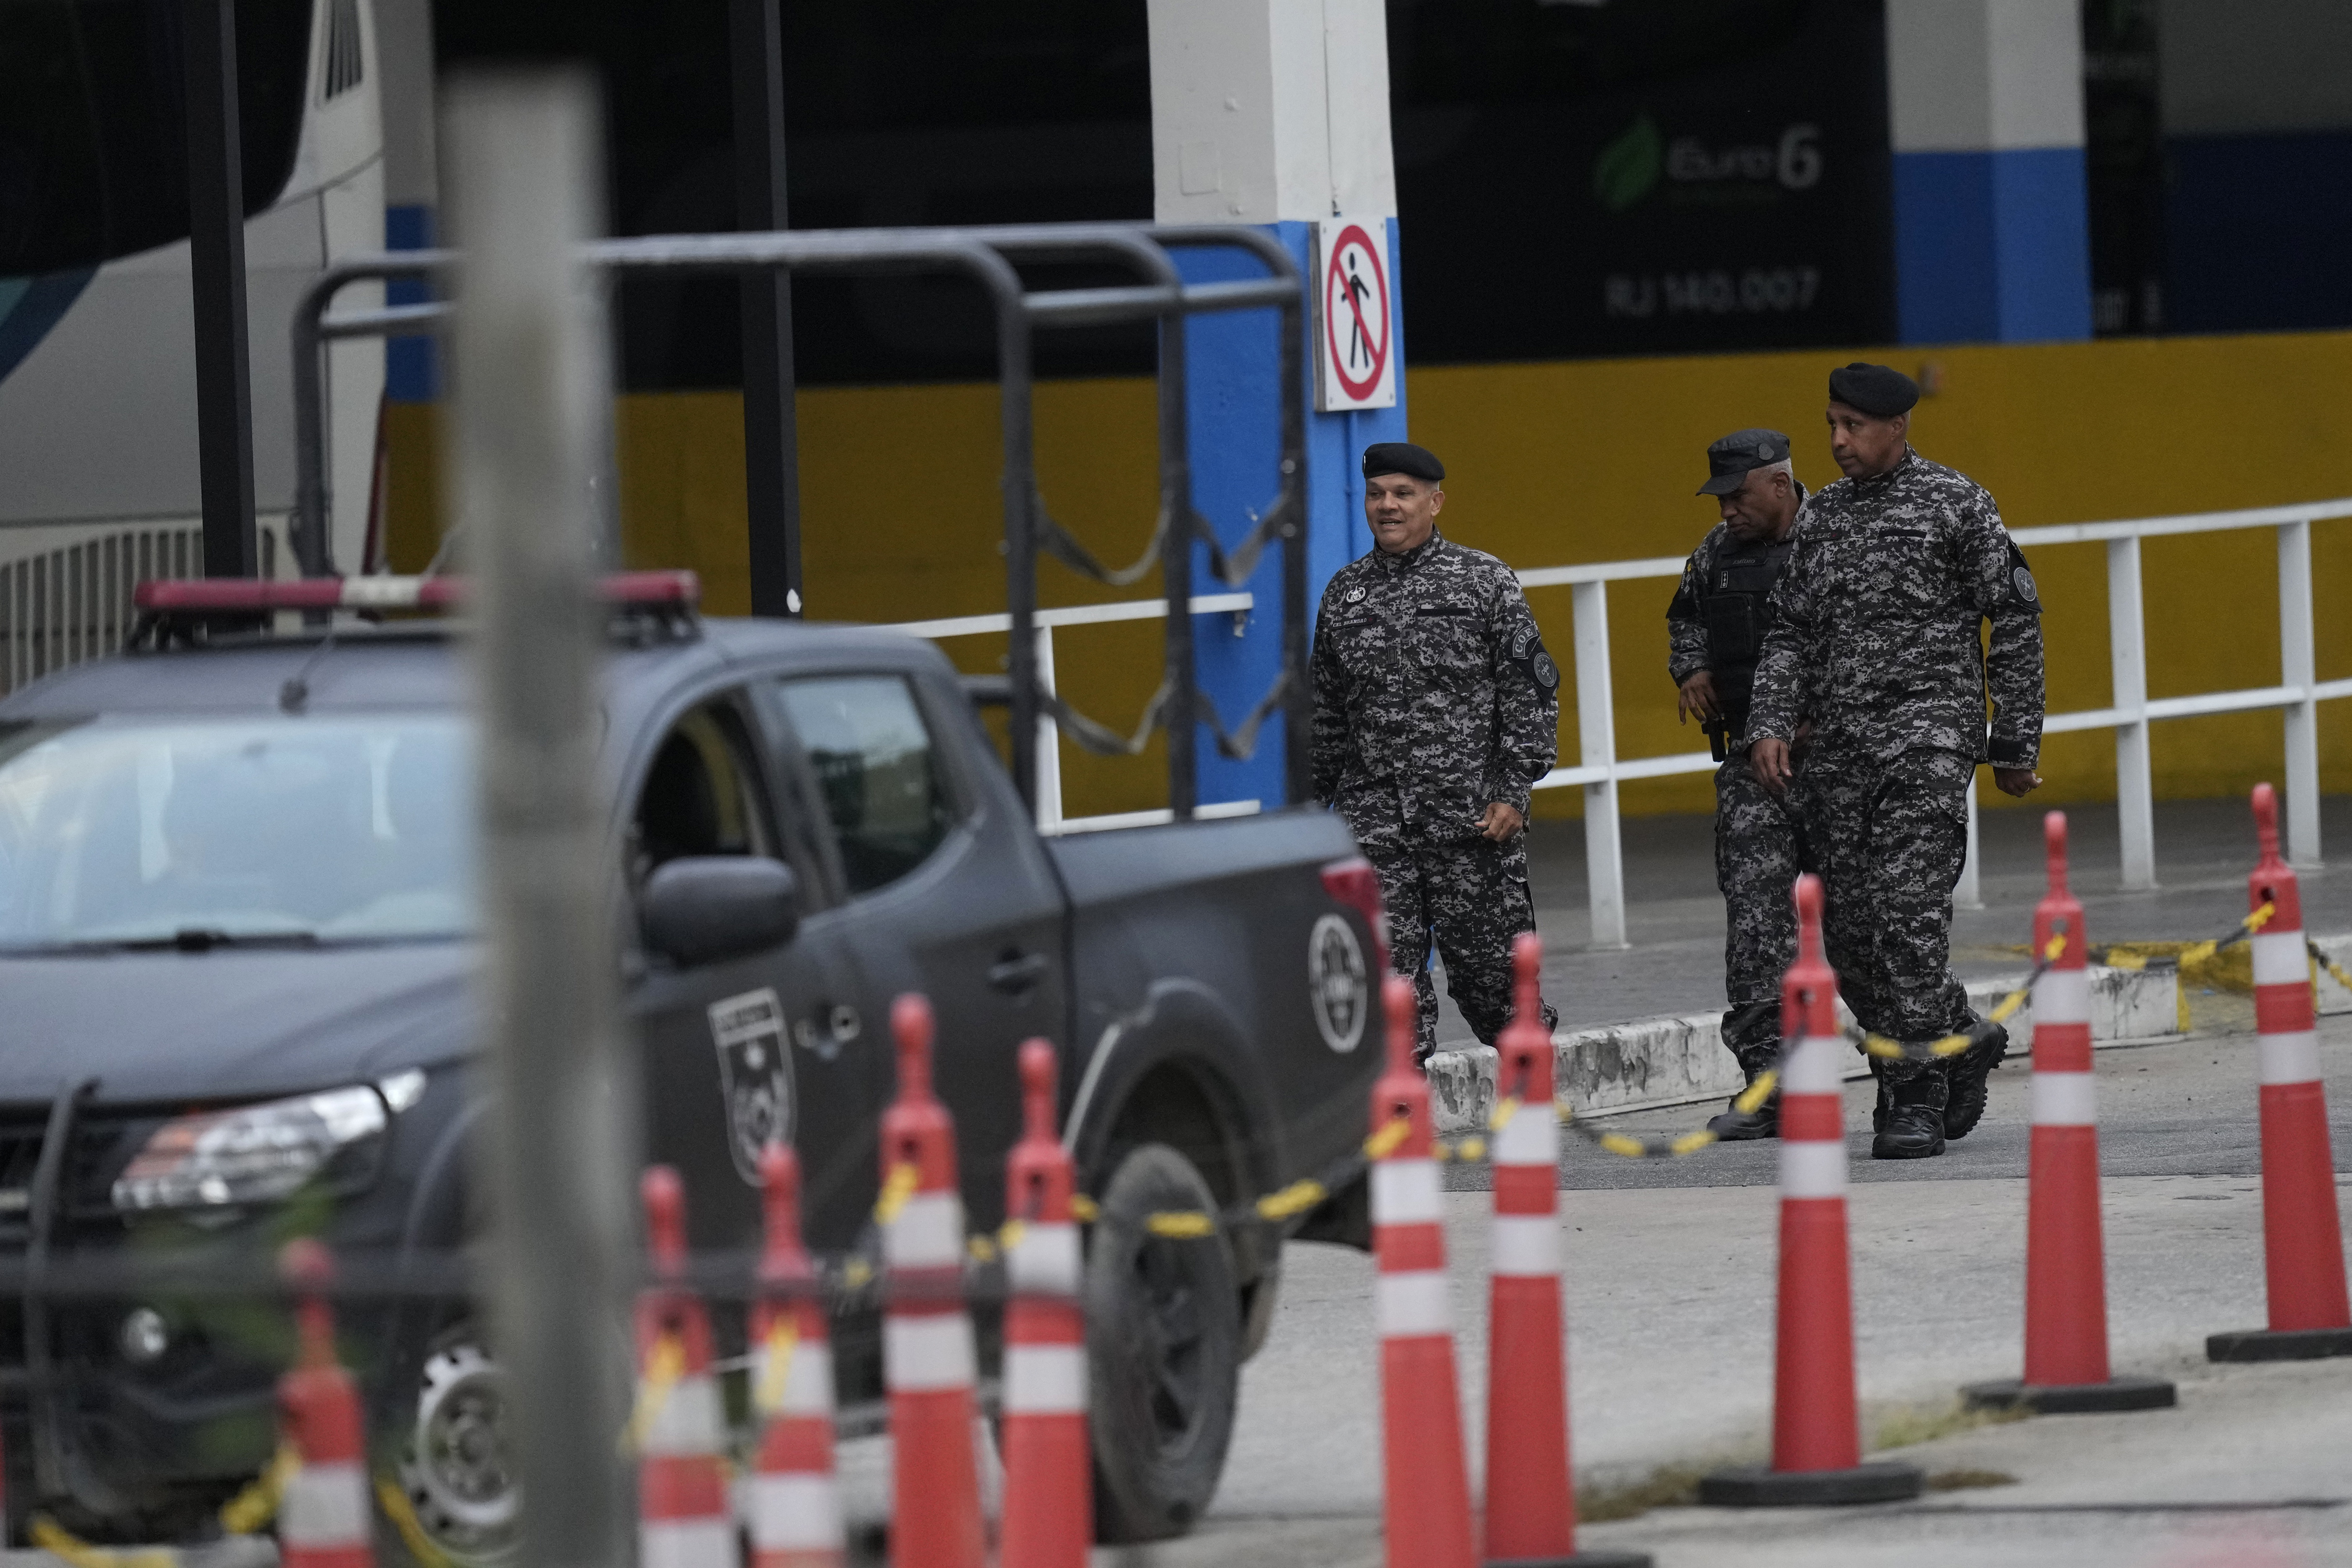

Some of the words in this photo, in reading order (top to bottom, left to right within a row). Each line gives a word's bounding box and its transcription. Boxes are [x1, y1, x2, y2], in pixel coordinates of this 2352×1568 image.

[1779, 123, 1822, 188] 6
[1606, 275, 1656, 316] RJ
[1515, 628, 1533, 653] COE
